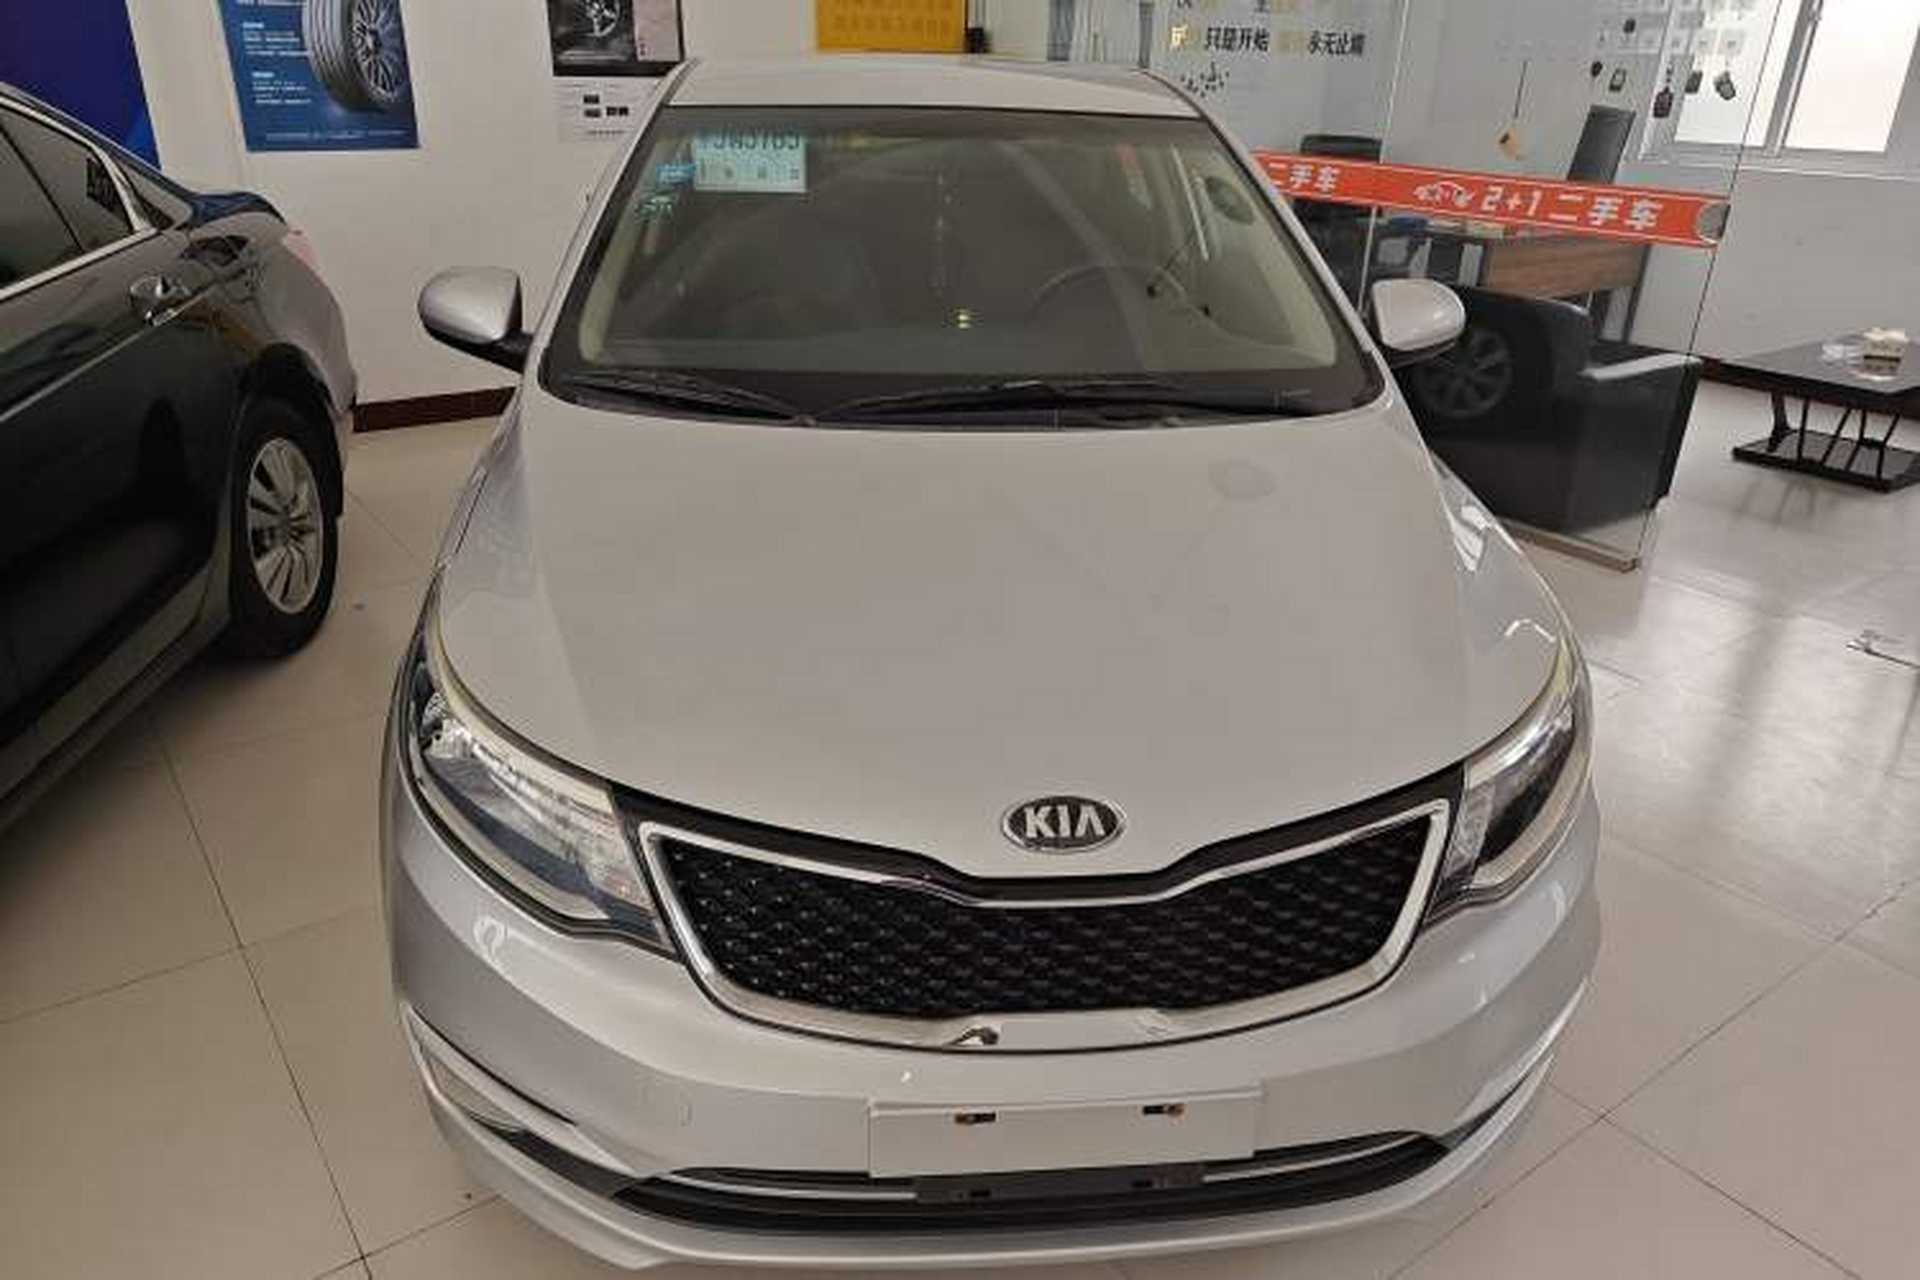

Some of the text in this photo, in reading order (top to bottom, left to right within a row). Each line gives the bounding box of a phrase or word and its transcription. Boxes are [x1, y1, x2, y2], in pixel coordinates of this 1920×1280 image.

[1268, 162, 1341, 193] 二手车
[1023, 804, 1106, 838] KIA
